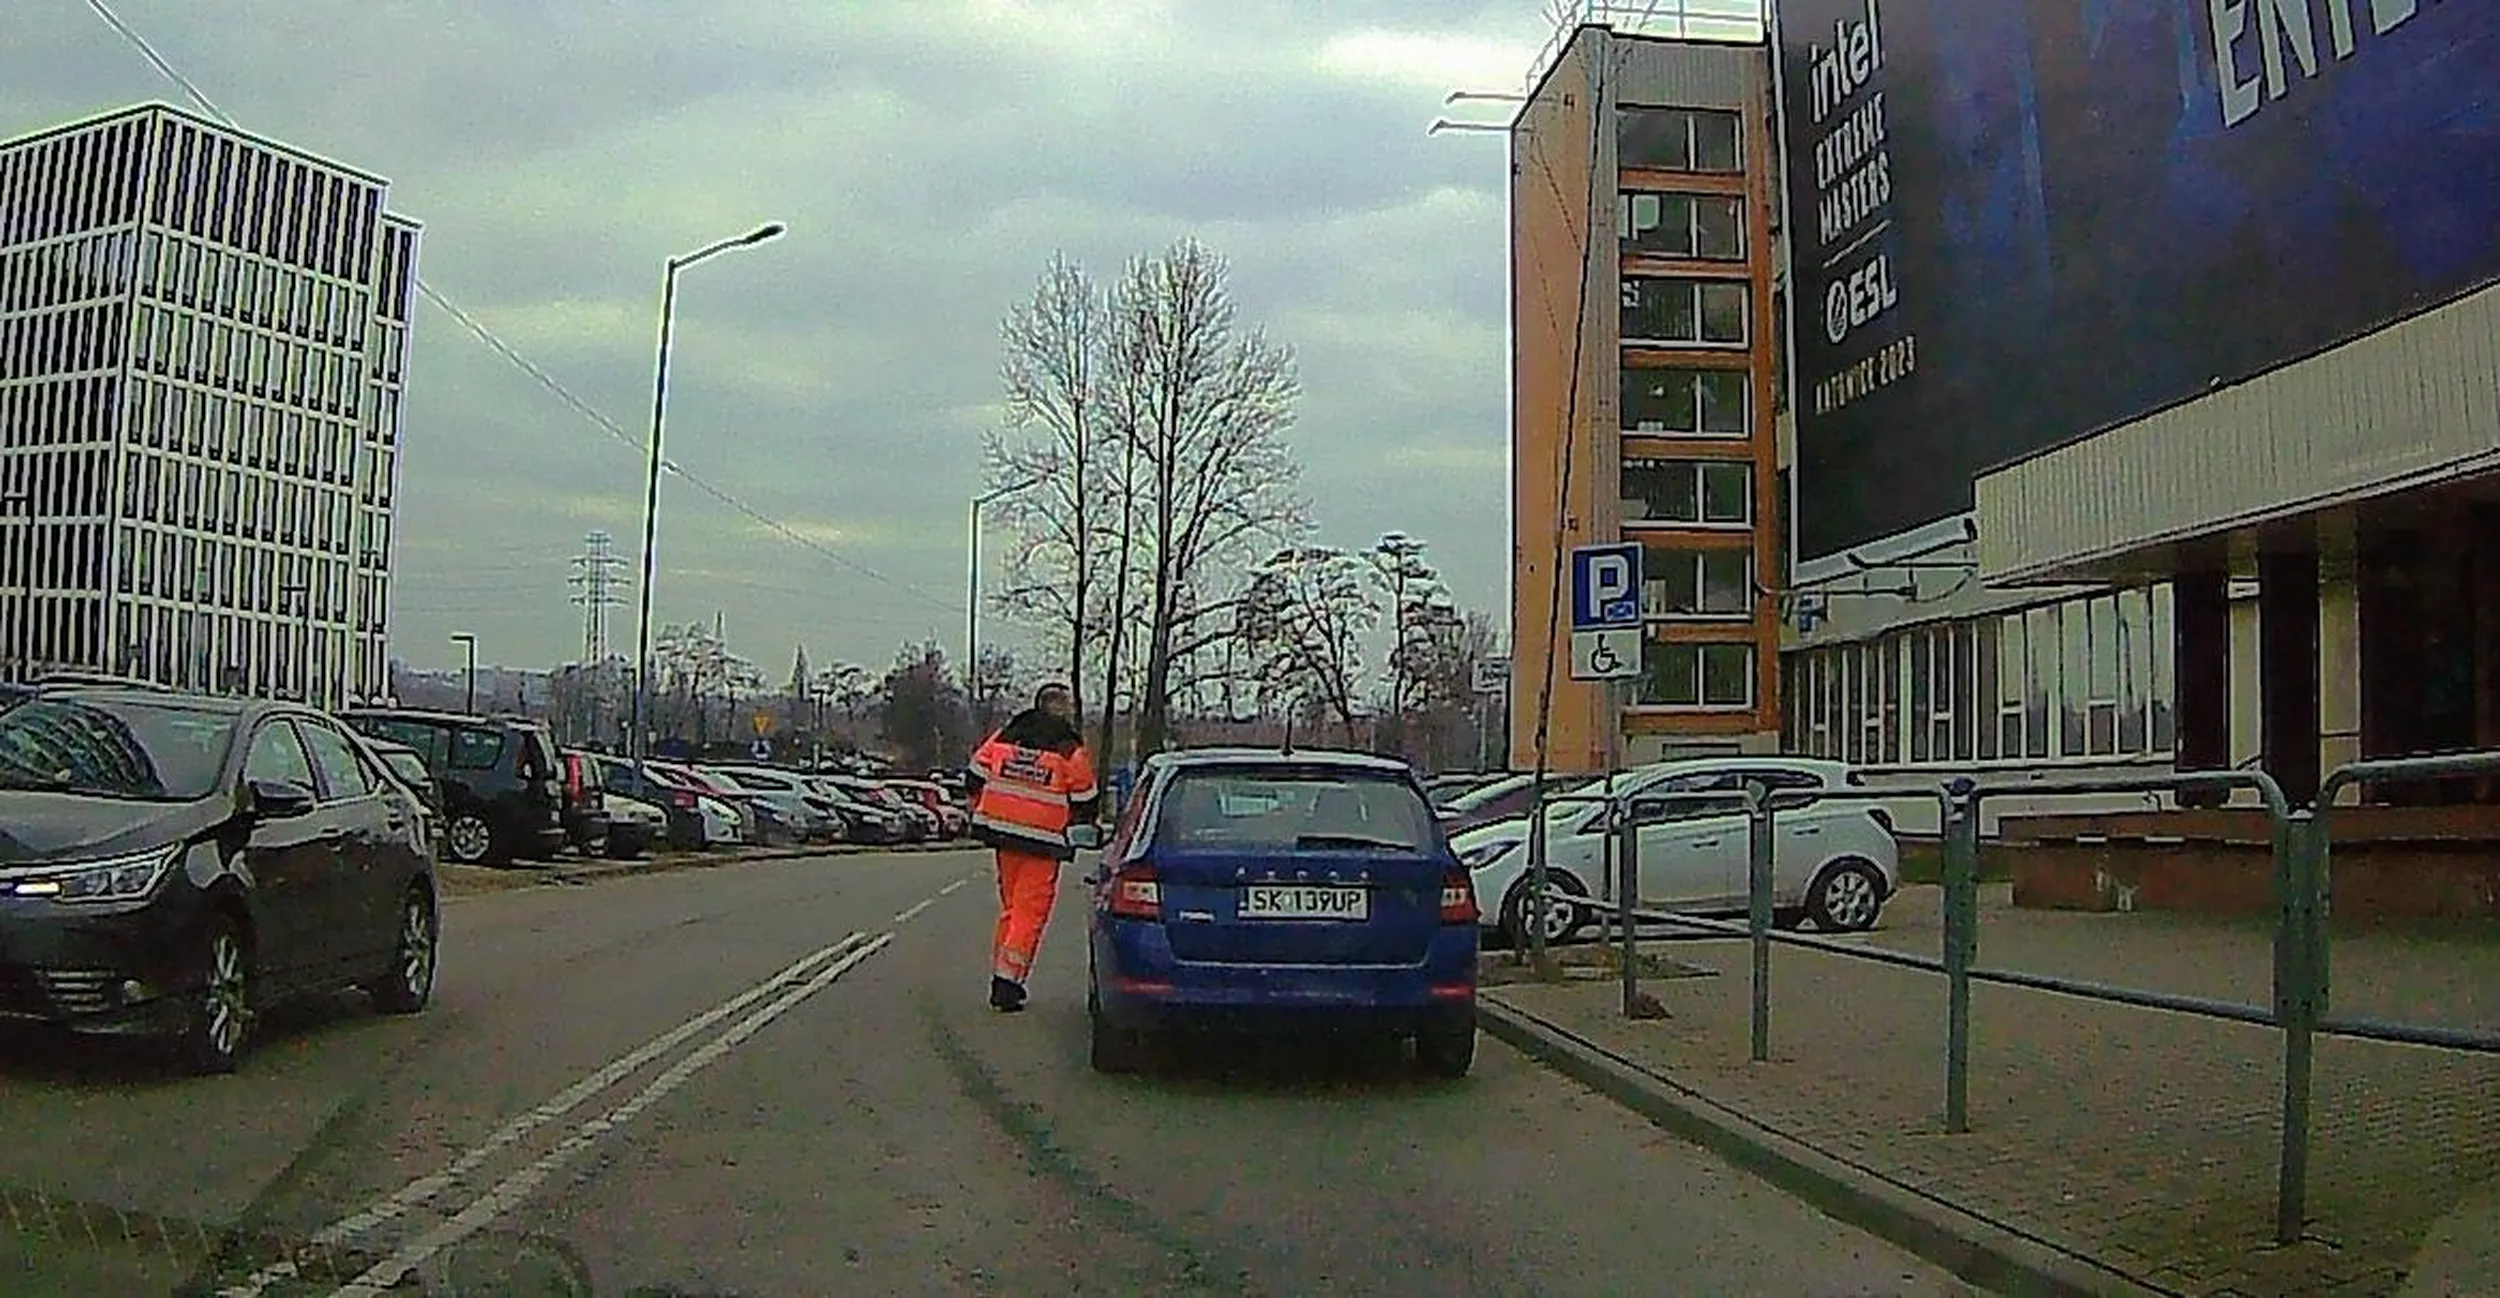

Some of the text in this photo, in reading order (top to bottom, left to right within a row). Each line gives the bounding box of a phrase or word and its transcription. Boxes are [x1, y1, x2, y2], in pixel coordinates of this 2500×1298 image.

[1809, 0, 1881, 123] intel
[1815, 92, 1884, 190] EXTREME
[1818, 150, 1891, 245] MASTERS
[1879, 335, 1915, 385] 2023
[1589, 554, 1629, 619] P
[1253, 889, 1282, 912] SK
